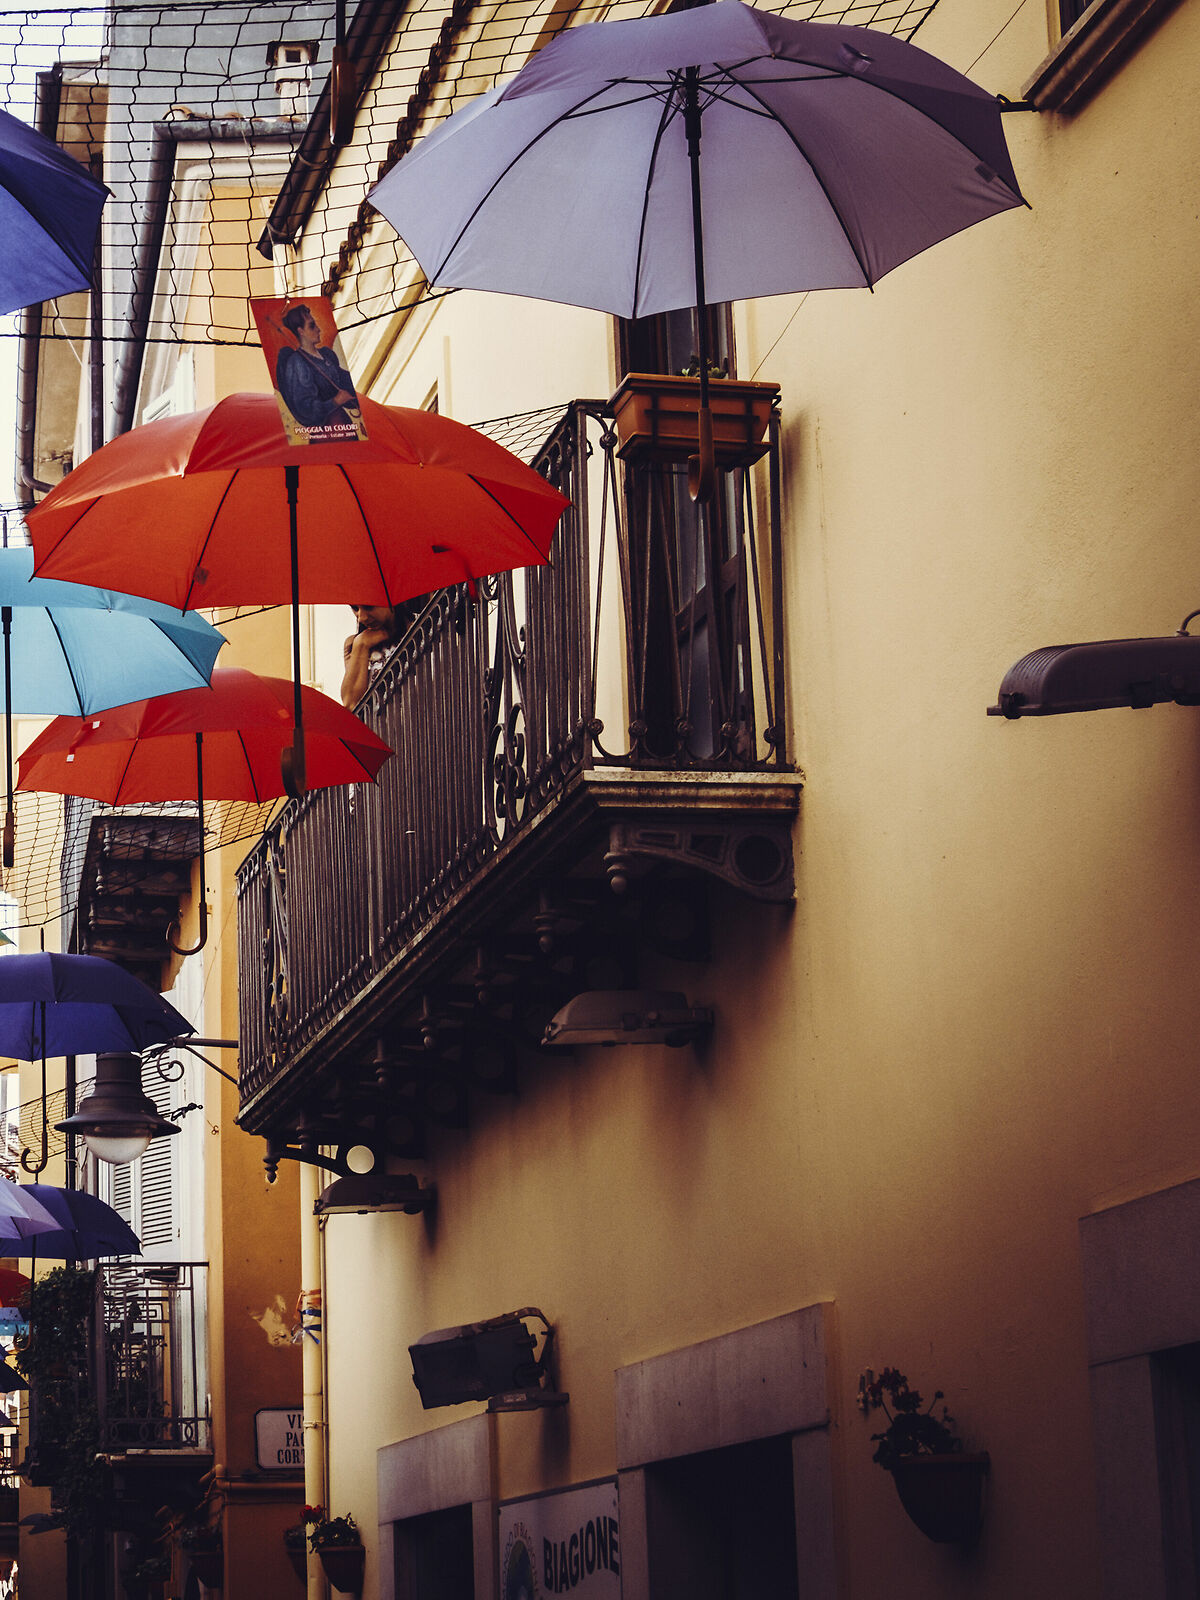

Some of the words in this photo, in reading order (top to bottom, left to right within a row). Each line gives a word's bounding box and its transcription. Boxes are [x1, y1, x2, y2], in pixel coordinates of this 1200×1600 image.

[294, 426, 324, 434] PIOGGIA
[333, 423, 358, 431] COLORI
[287, 1414, 304, 1429] VI
[543, 1516, 619, 1593] BIAGIONE
